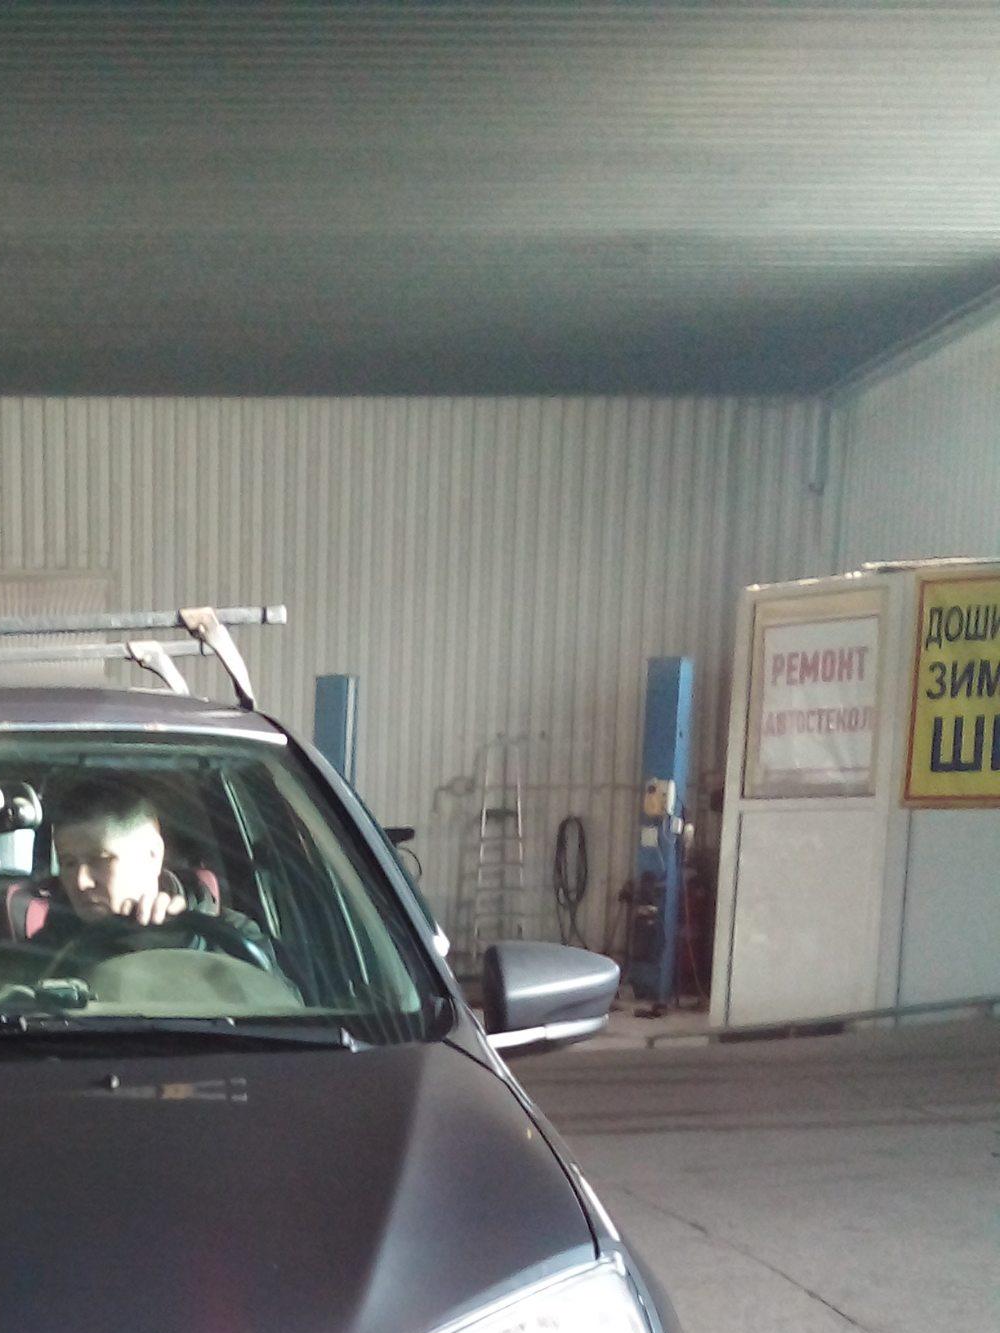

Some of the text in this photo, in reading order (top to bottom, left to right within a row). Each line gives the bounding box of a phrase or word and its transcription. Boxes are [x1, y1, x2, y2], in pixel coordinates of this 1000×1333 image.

[770, 646, 867, 686] РЕМОНТ
[926, 658, 1000, 699] ЗИМ
[763, 705, 872, 737] АВТОСТЕКОЛ
